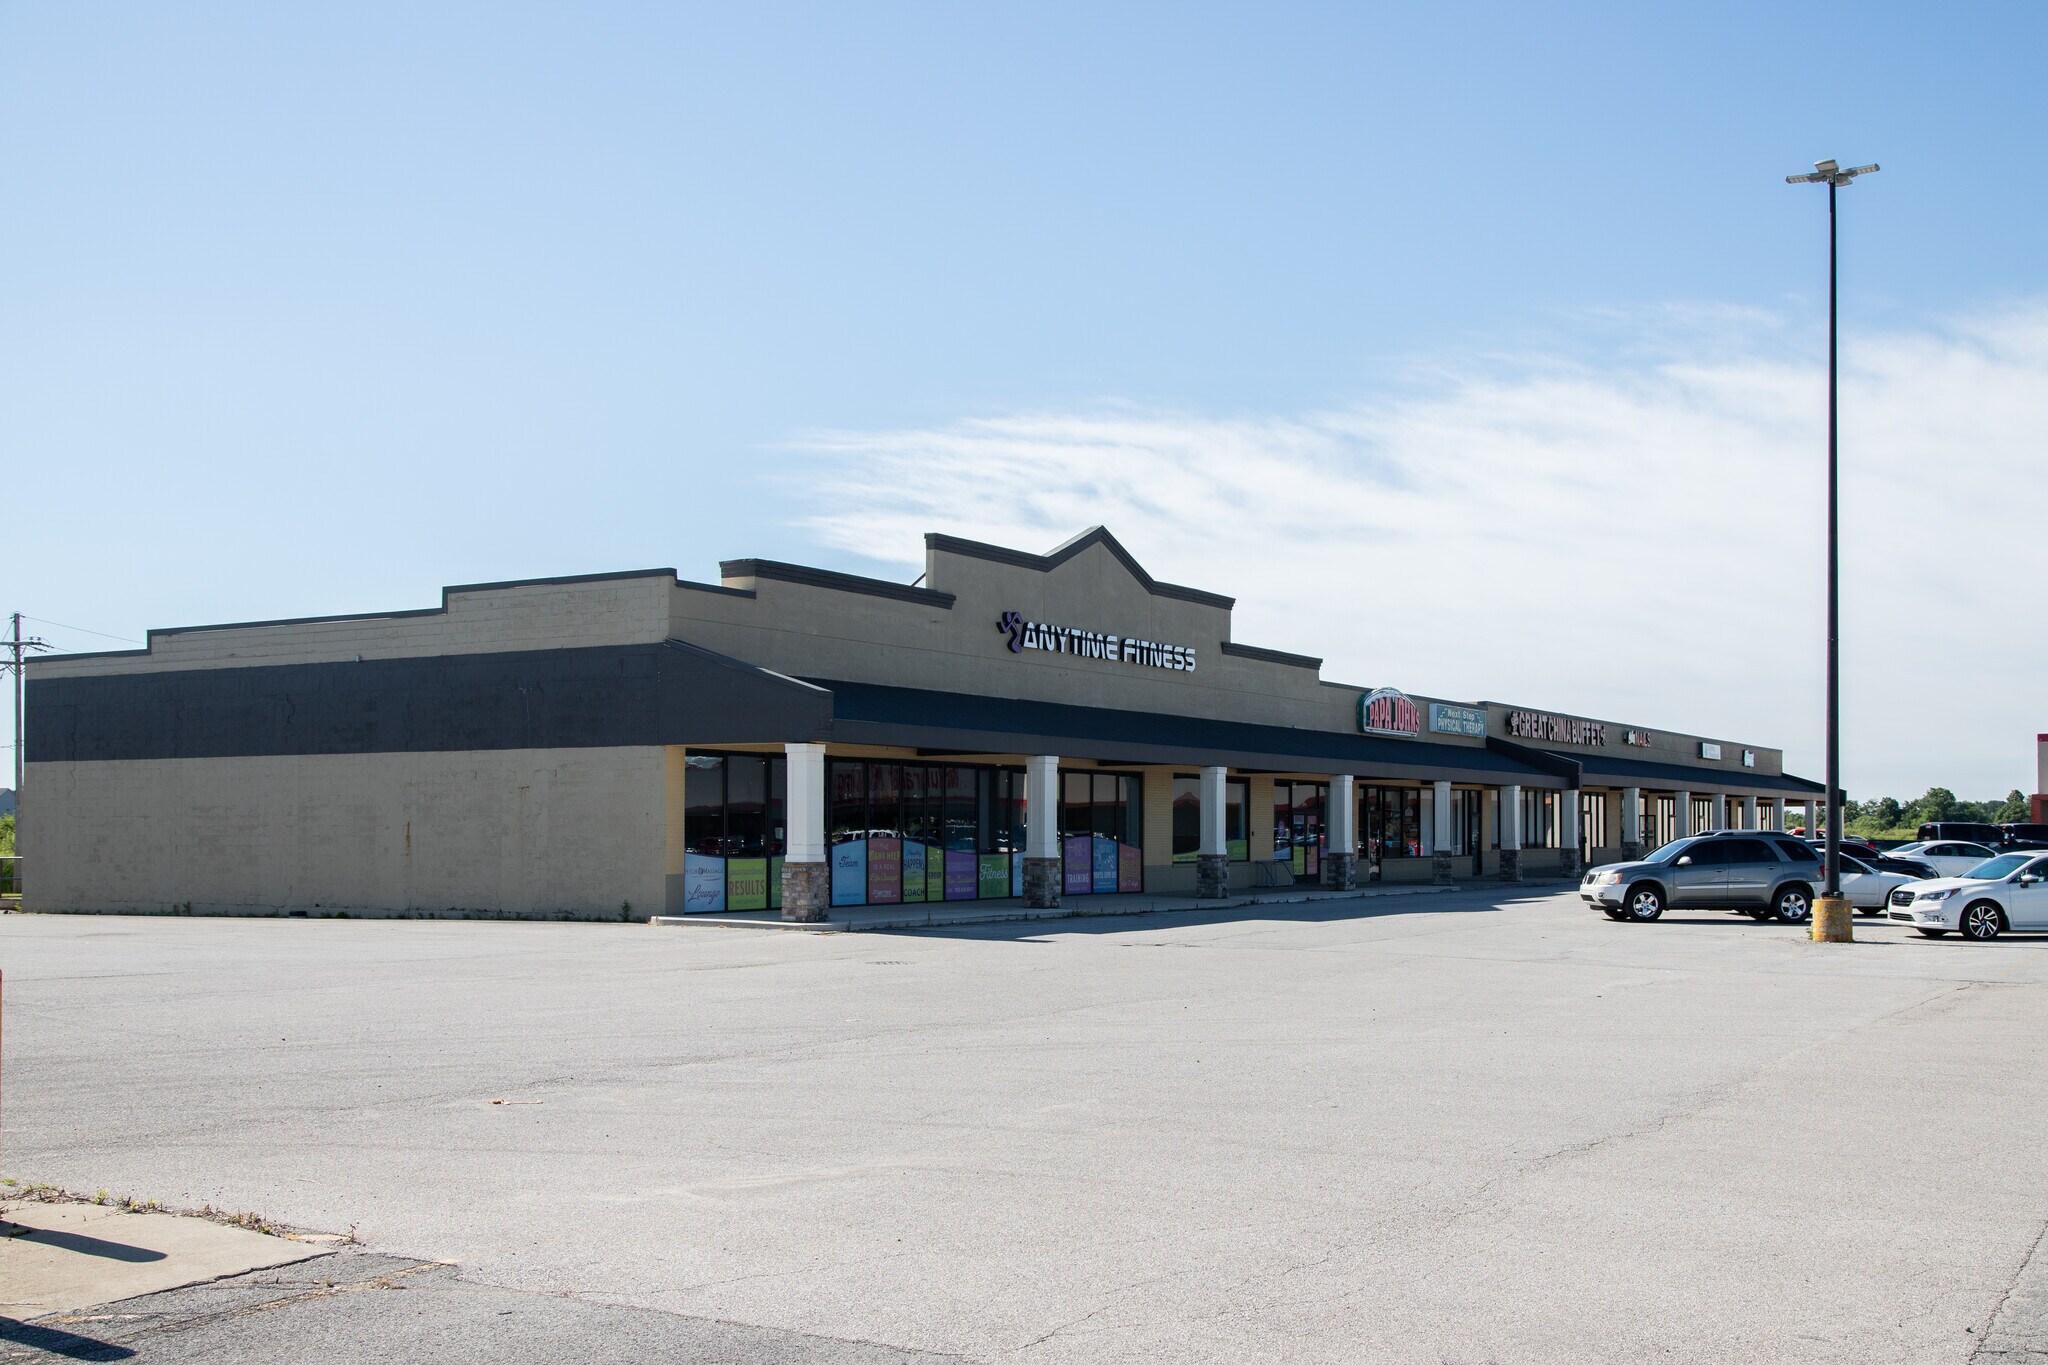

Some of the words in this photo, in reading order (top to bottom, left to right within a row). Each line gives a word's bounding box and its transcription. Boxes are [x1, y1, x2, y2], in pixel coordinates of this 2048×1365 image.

[1022, 621, 1118, 661] ANYTIME
[1120, 638, 1196, 672] FITNESS
[1369, 696, 1392, 730] PAPA
[1447, 708, 1461, 719] Next
[1462, 710, 1476, 721] Step
[1437, 718, 1461, 732] PHYSICAL
[1462, 721, 1485, 735] THERAPY
[1519, 711, 1548, 739] GREAT
[1548, 716, 1571, 743] CHINA
[1571, 720, 1601, 746] BUFFET
[838, 855, 859, 868] Team
[886, 850, 900, 861] HELP
[979, 863, 1008, 881] Fitness
[1067, 872, 1090, 884] TRAINING
[688, 884, 721, 905] Lounge
[728, 879, 765, 897] RESULTS
[903, 887, 925, 897] COACH
